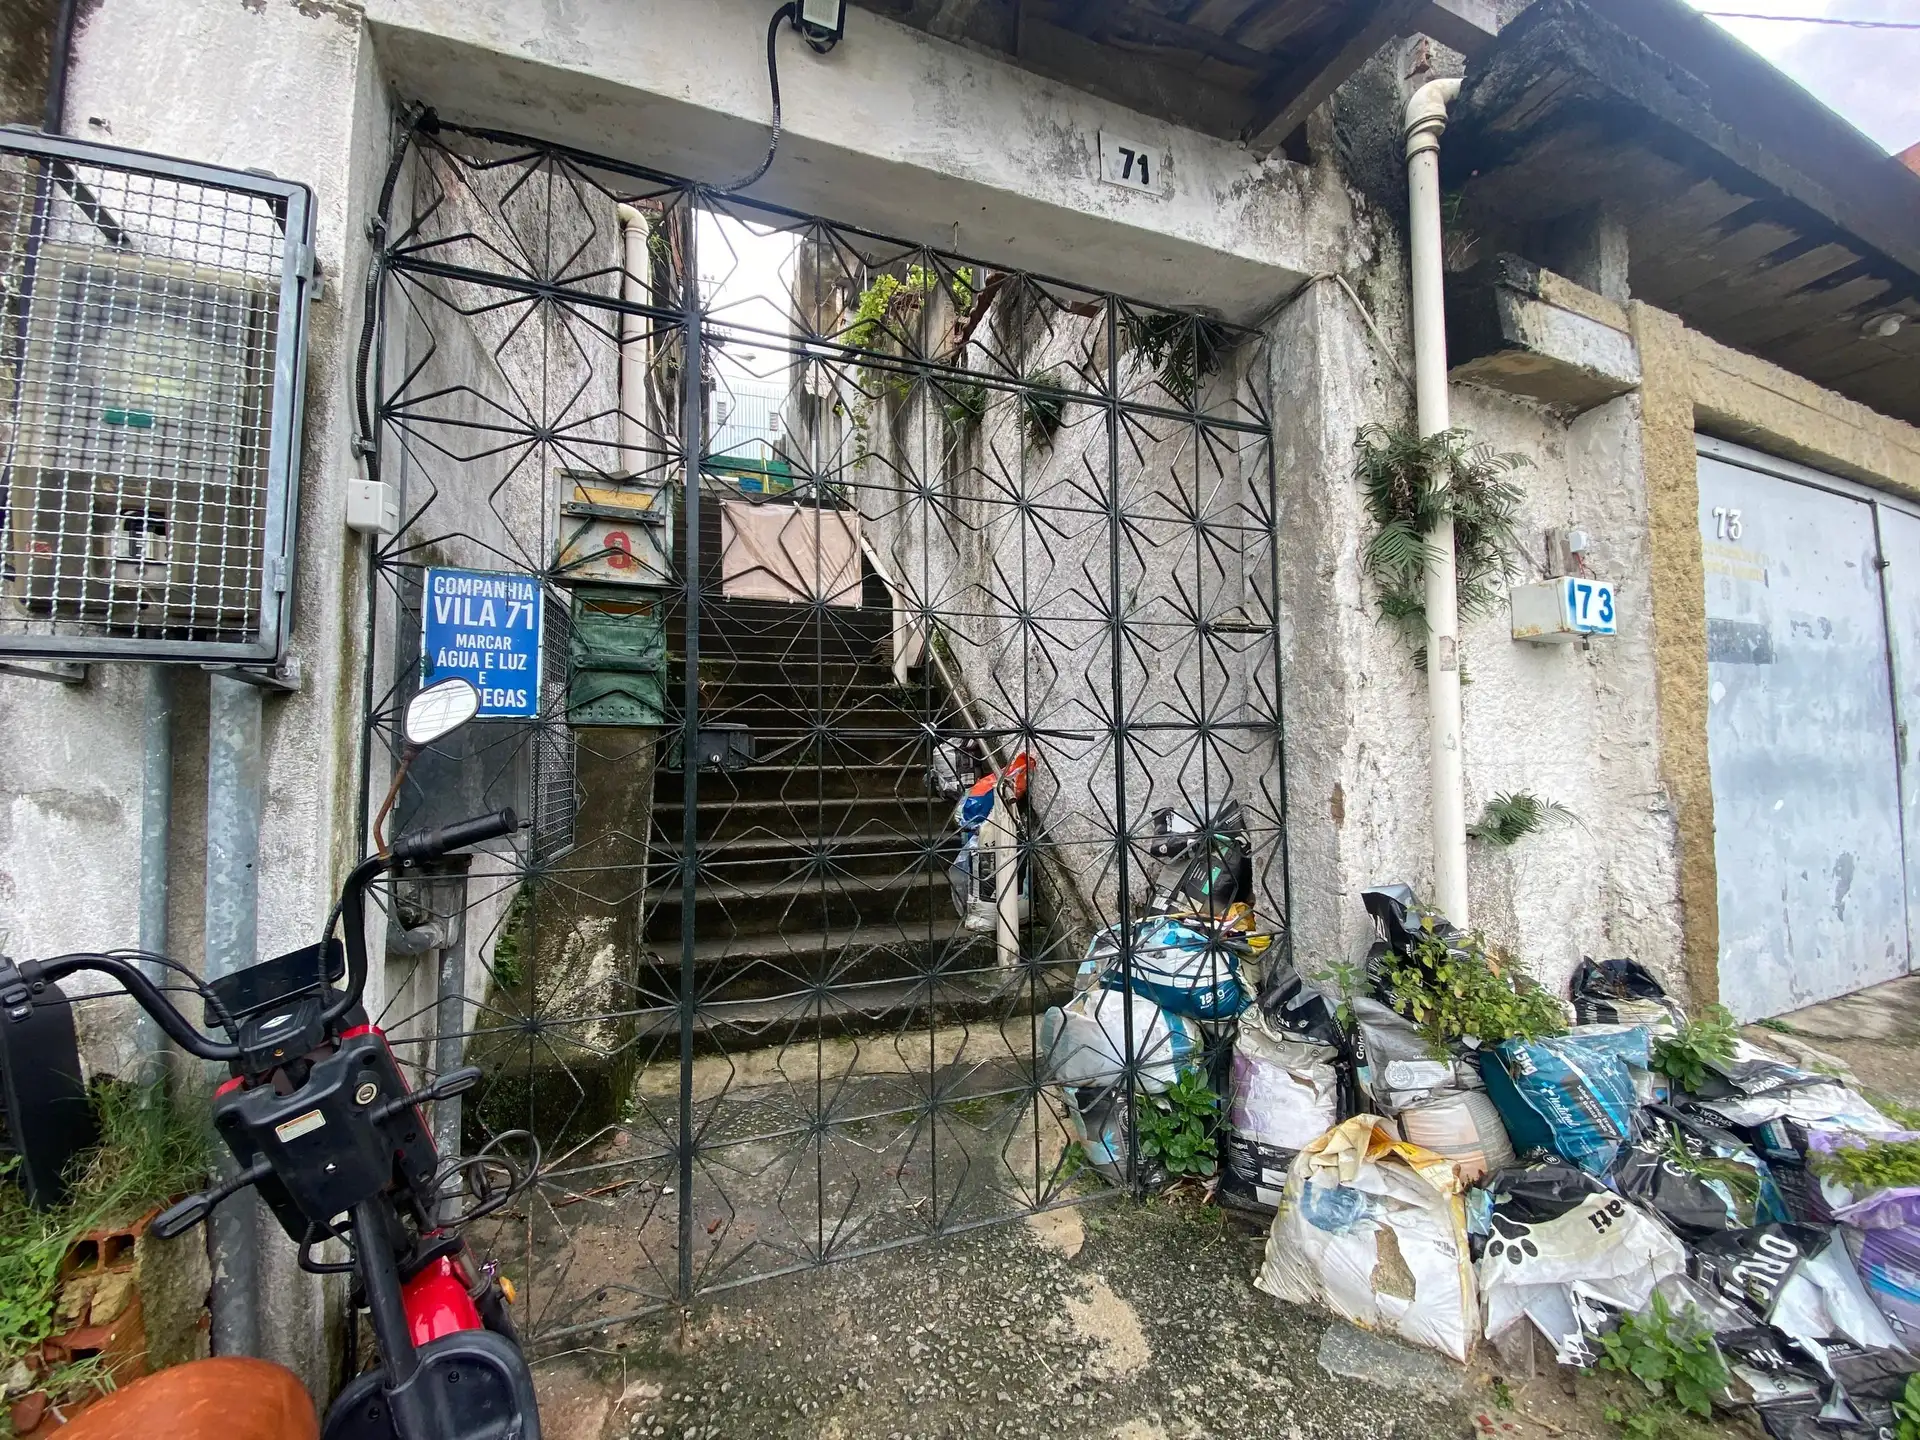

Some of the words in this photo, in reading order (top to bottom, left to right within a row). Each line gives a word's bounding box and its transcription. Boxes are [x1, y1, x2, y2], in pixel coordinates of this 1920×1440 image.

[1118, 146, 1149, 185] 71
[1712, 507, 1742, 540] 73
[434, 576, 534, 601] COMPANHIA
[434, 596, 497, 628] VILA
[505, 601, 534, 630] 71
[1577, 584, 1613, 622] 73
[456, 633, 512, 650] MARCAR
[436, 647, 479, 668] ÁGUA
[485, 652, 494, 669] E
[500, 654, 527, 671] LUZ
[479, 671, 487, 685] E
[477, 688, 527, 708] EGAS
